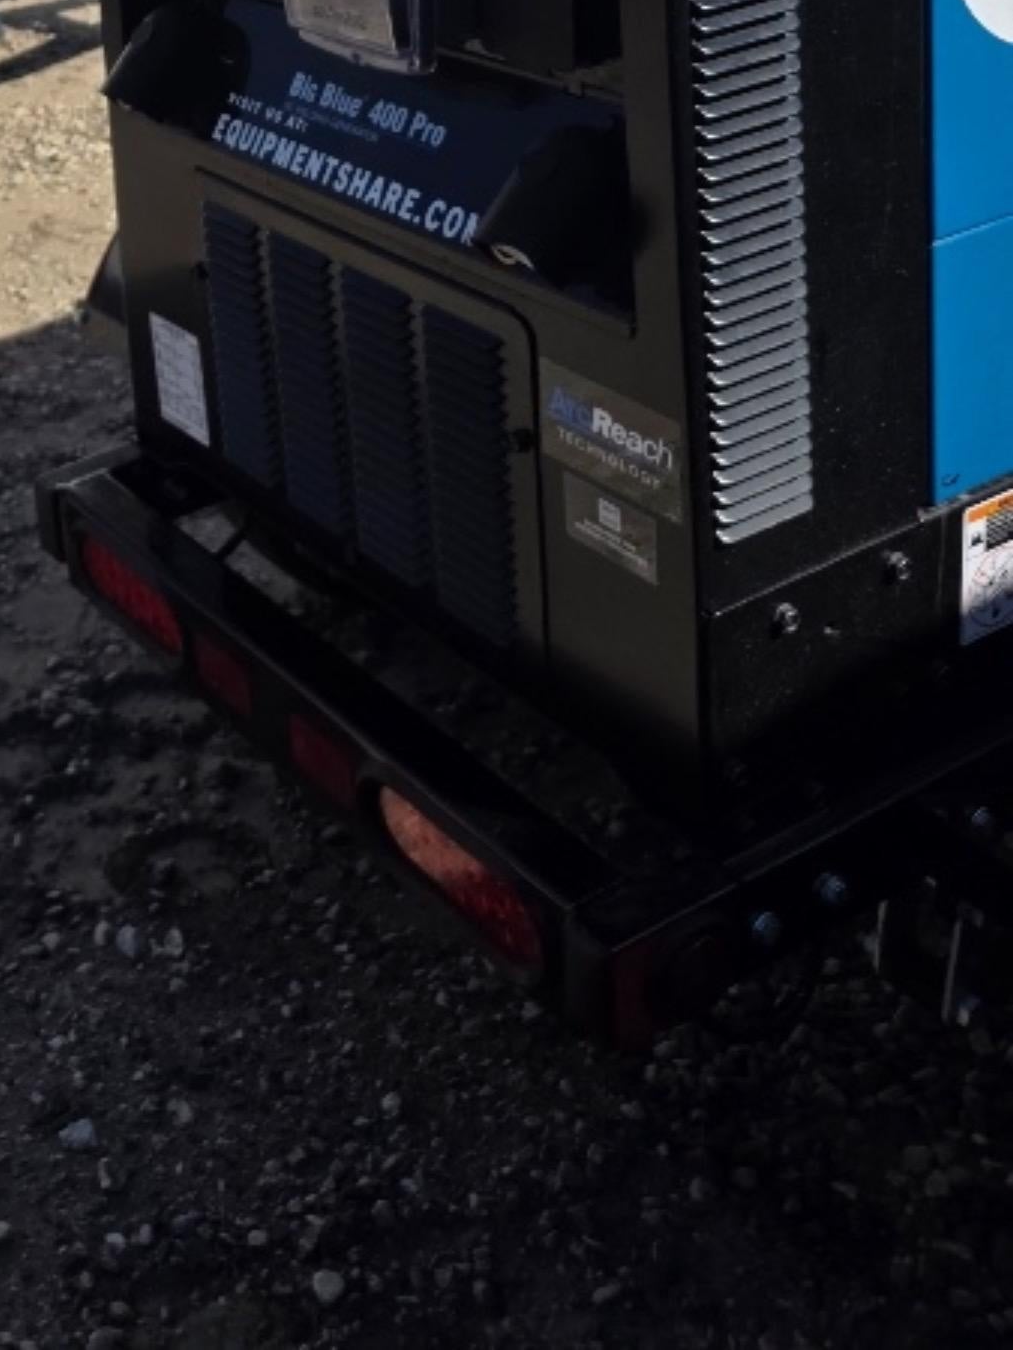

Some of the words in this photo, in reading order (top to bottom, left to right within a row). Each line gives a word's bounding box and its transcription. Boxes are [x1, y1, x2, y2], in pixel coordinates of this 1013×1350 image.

[320, 82, 362, 115] Blue
[368, 98, 408, 133] 400
[408, 111, 447, 148] Pro
[549, 387, 672, 470] ArcReach
[557, 427, 661, 489] TECHNOLOGY
